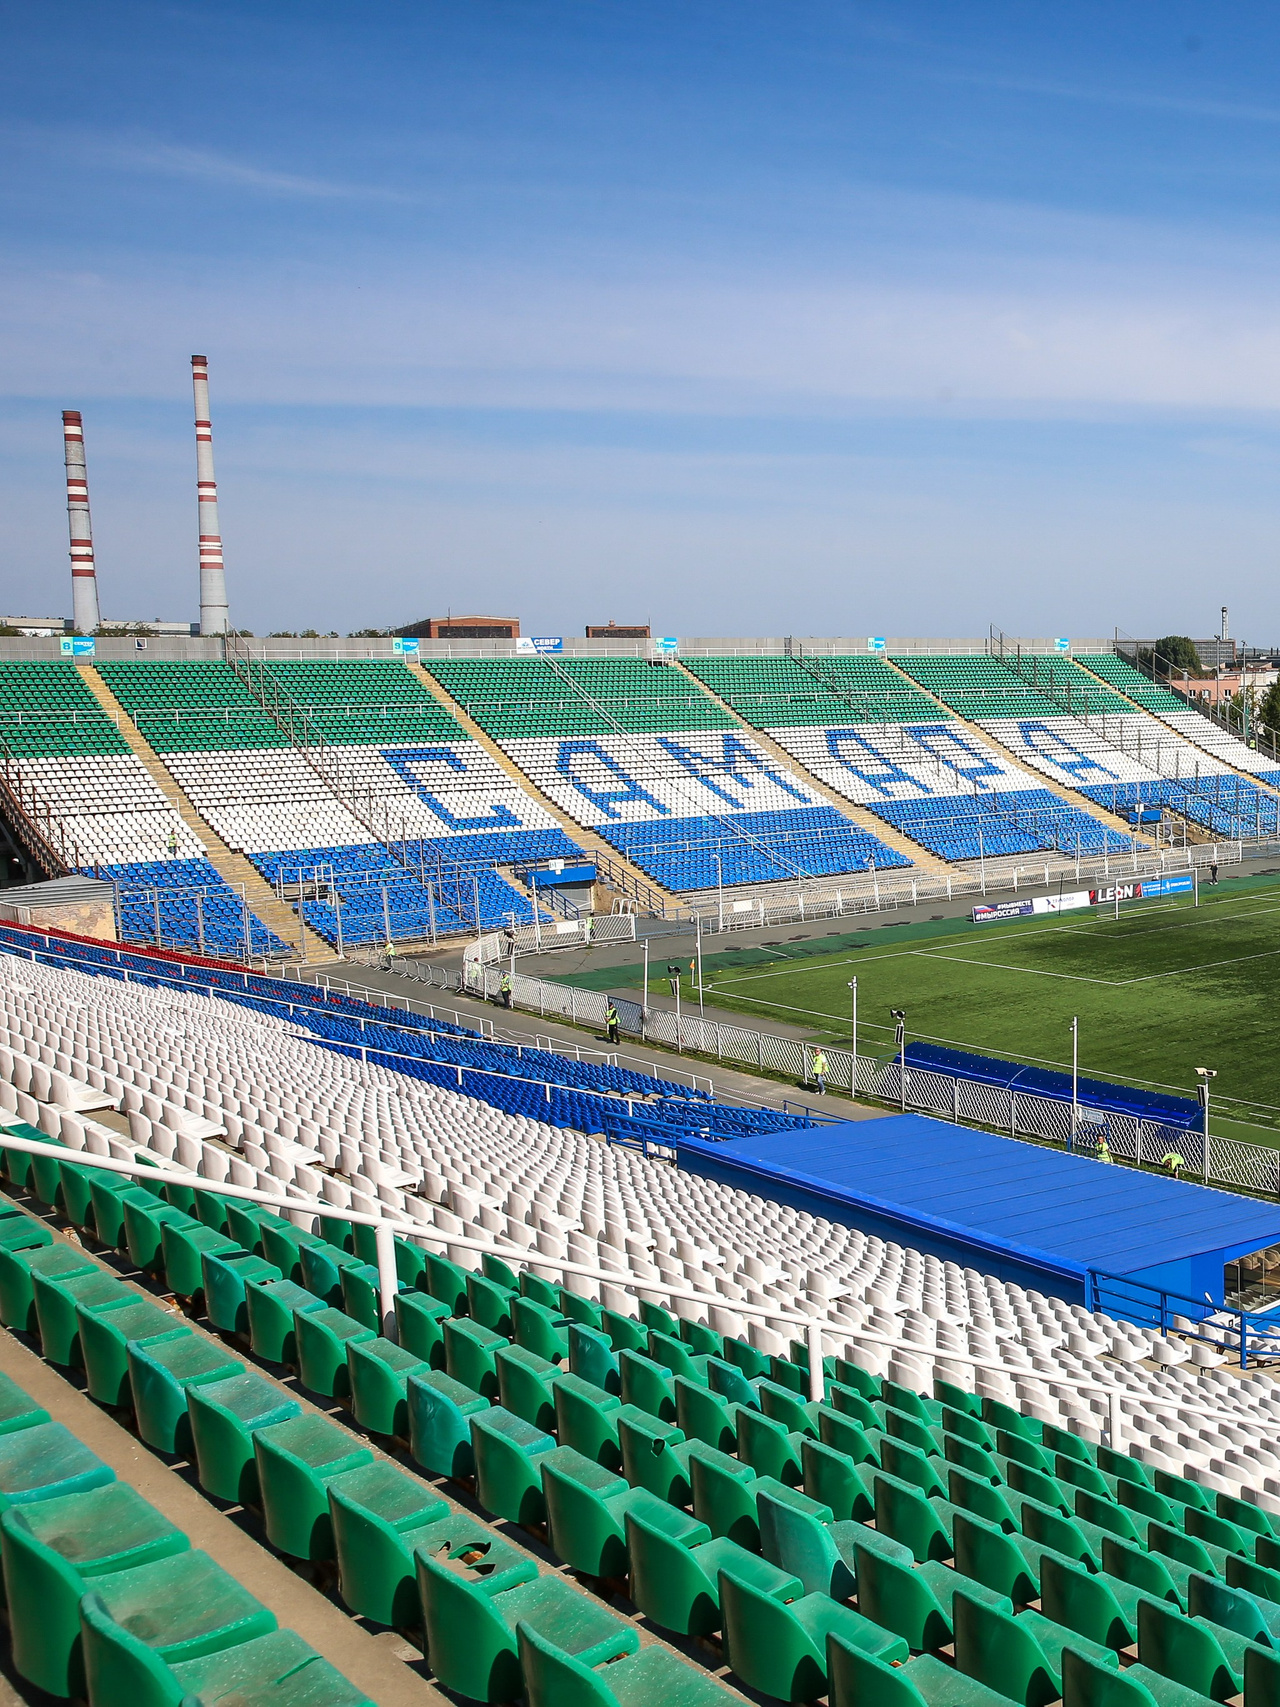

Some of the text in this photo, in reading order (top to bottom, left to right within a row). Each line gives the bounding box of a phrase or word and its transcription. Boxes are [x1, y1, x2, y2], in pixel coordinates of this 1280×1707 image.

[63, 642, 71, 650] 8
[534, 638, 561, 646] СЕВЕР
[380, 722, 1120, 830] САМАРА
[1098, 884, 1133, 902] LEON
[997, 900, 1032, 909] #МЫВМЕСТЕ
[975, 907, 1020, 920] #МЫРОССИЯ
